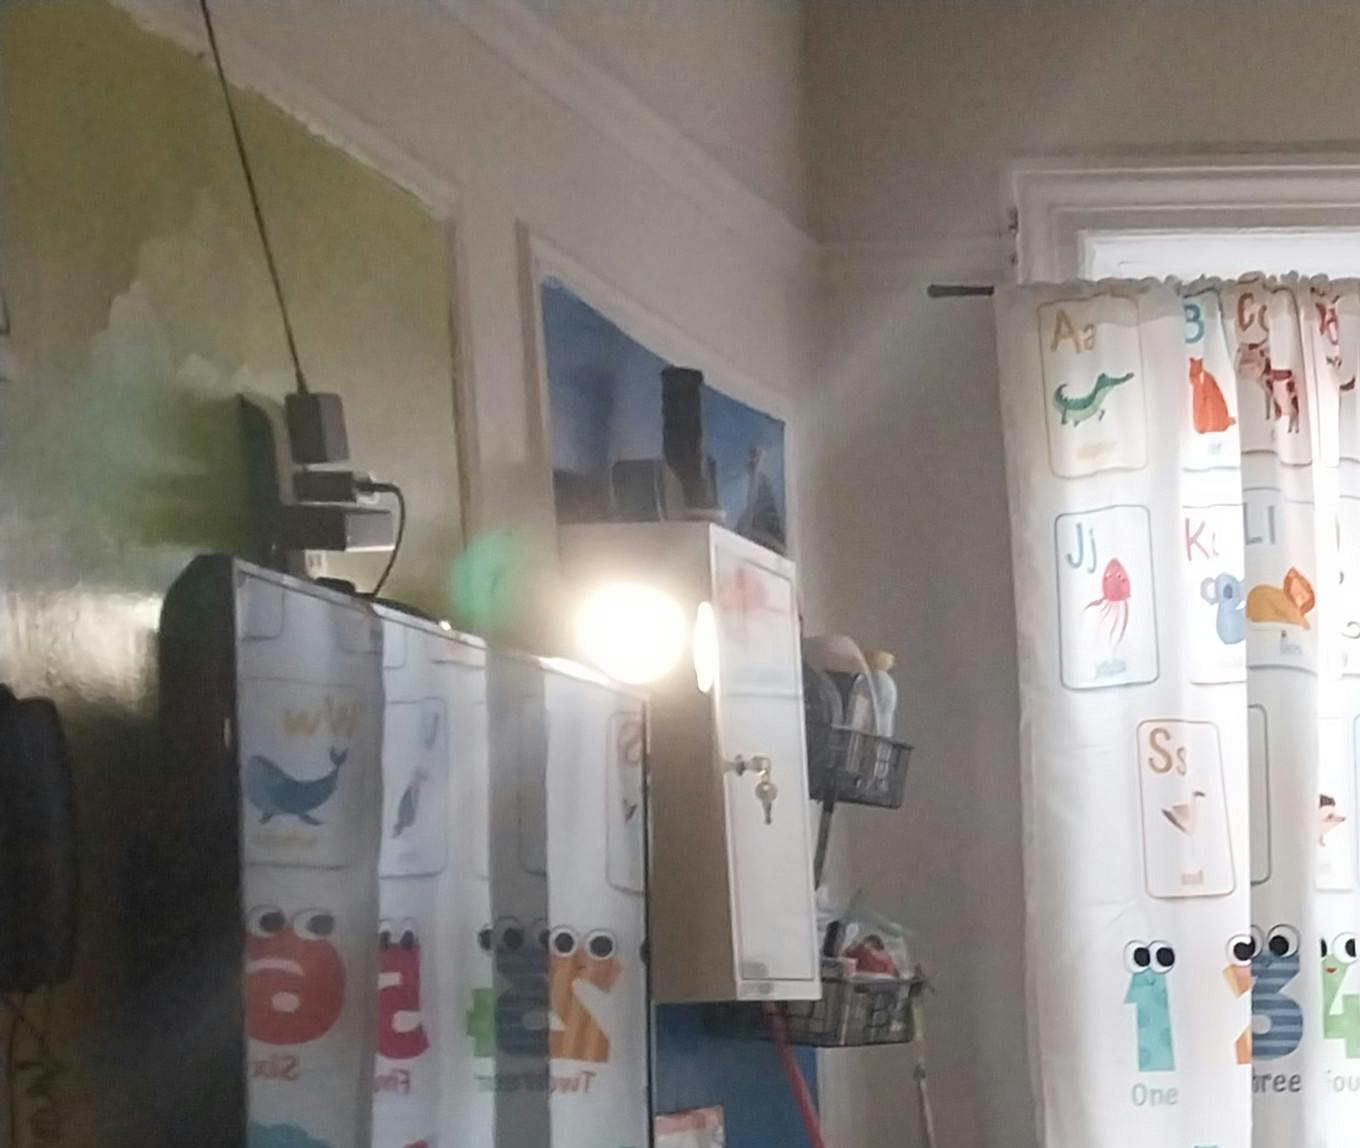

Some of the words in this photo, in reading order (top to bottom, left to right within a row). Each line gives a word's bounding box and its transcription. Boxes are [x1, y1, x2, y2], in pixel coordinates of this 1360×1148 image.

[1050, 307, 1096, 355] Aa
[1065, 522, 1098, 574] Jj
[1148, 726, 1188, 777] Ss
[1123, 970, 1176, 1072] 1
[1130, 1082, 1180, 1107] One
